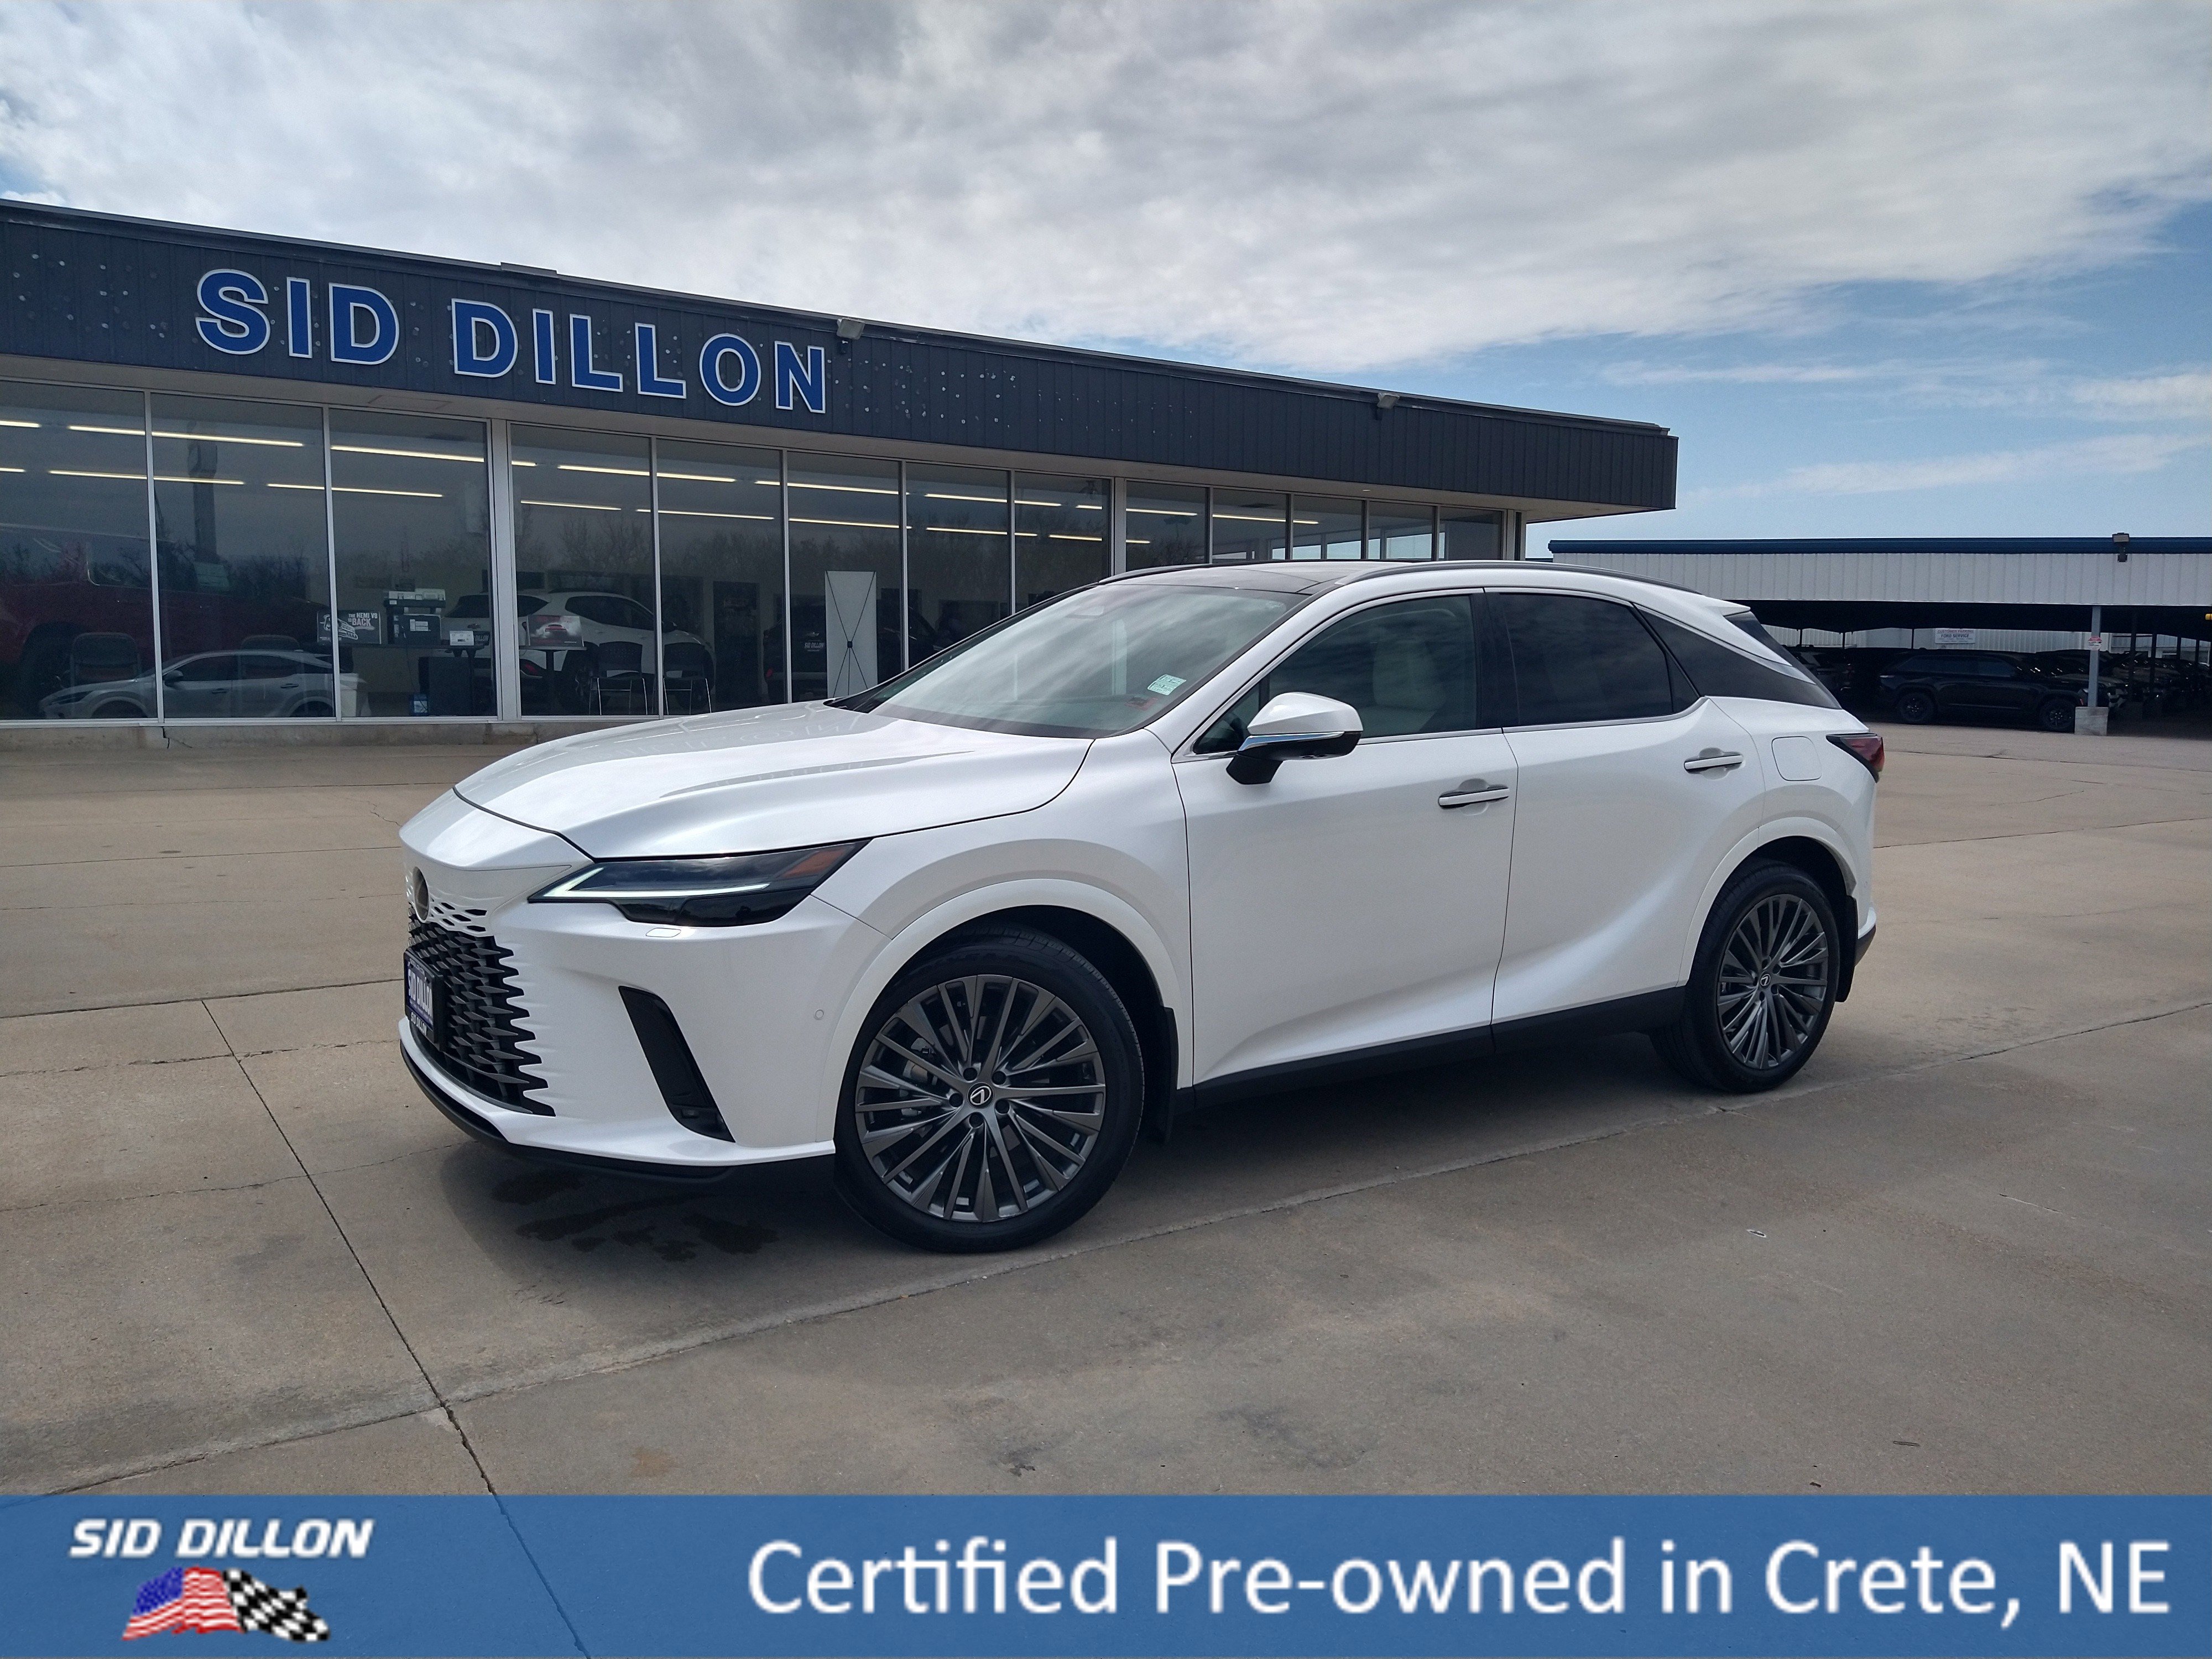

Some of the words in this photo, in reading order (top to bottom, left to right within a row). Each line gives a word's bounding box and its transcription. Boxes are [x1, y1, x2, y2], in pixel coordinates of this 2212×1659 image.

[195, 269, 399, 365] SID
[451, 299, 826, 414] DILLON
[352, 618, 371, 627] BACK
